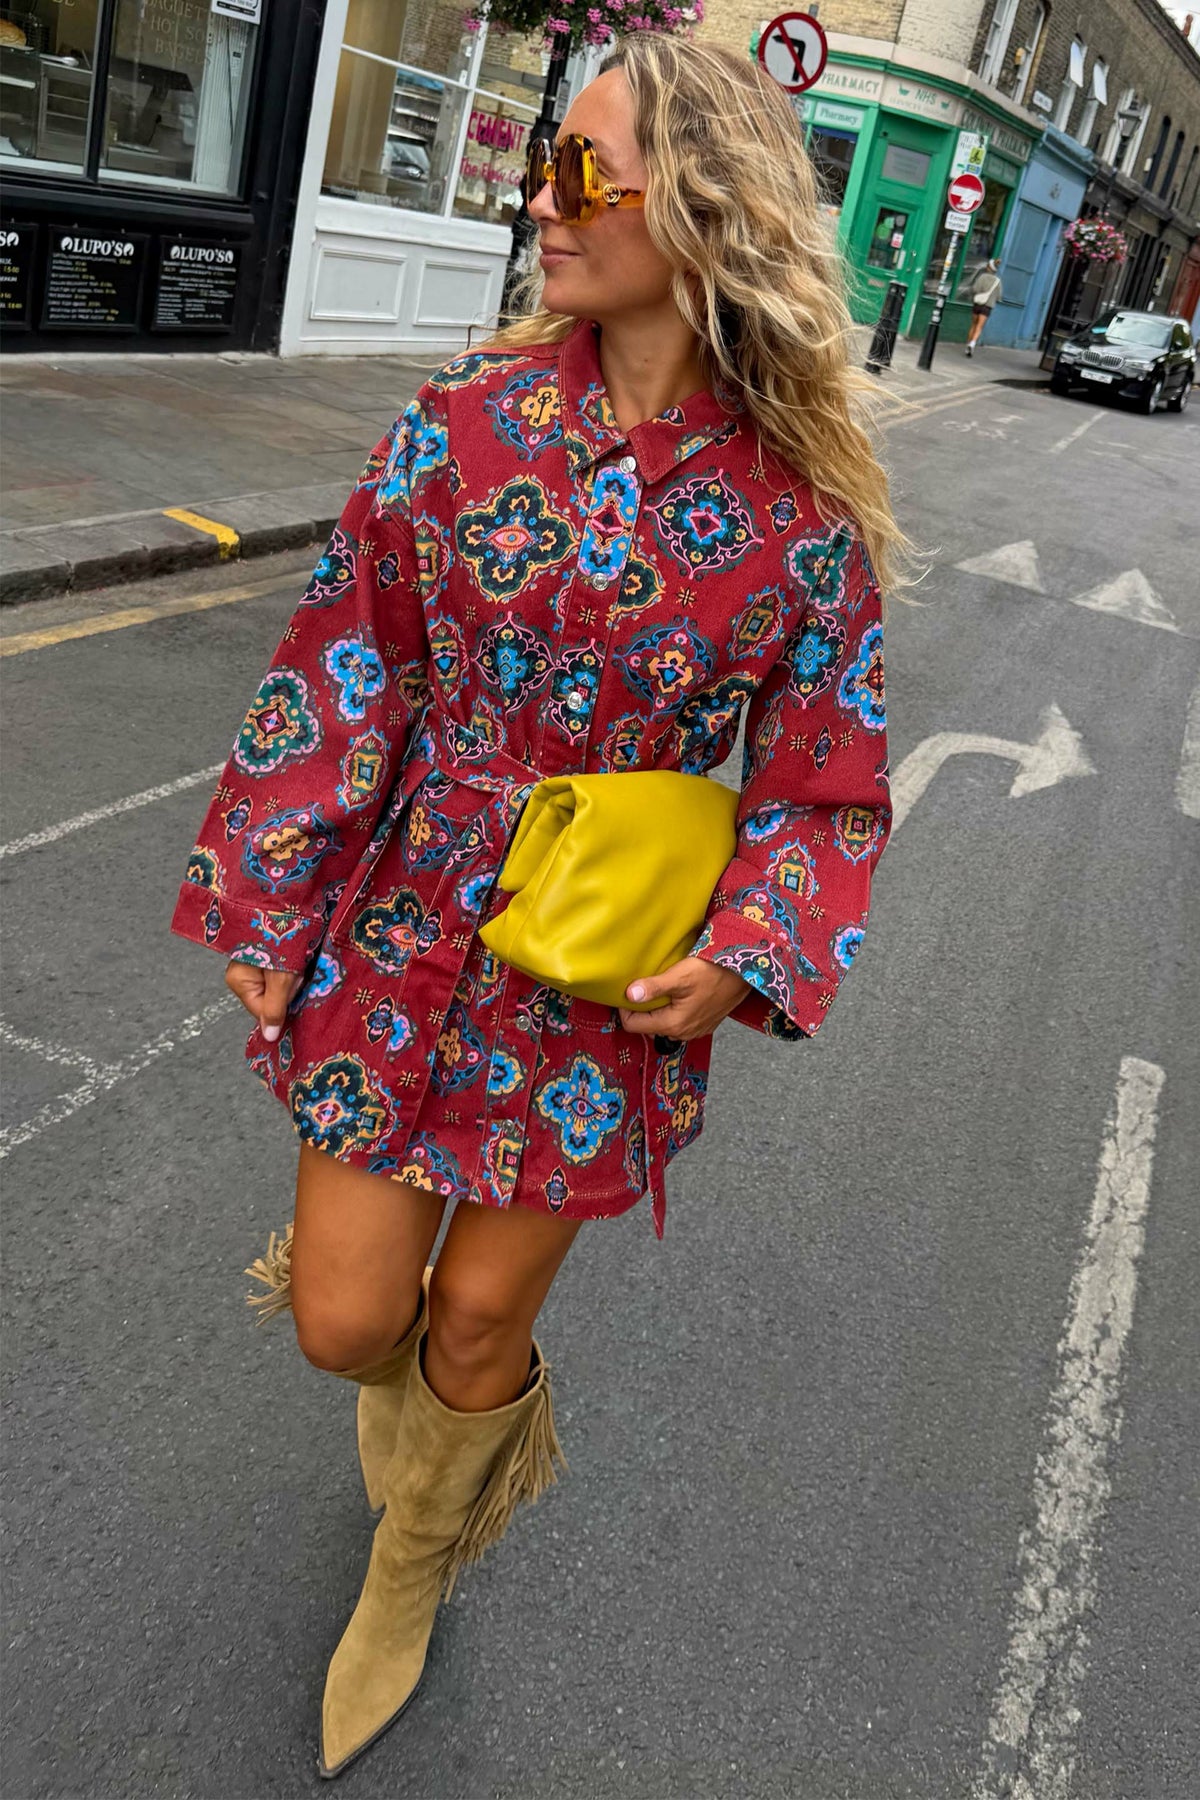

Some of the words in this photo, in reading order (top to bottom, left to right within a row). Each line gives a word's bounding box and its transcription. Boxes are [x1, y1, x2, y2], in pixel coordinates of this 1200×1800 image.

[820, 73, 880, 96] PHARMACY
[915, 88, 939, 105] NHS
[820, 107, 859, 125] Pharmacy
[467, 111, 525, 152] CEMENT
[461, 156, 478, 177] The
[73, 238, 124, 258] LUPO'S
[180, 246, 226, 264] LUPO'S
